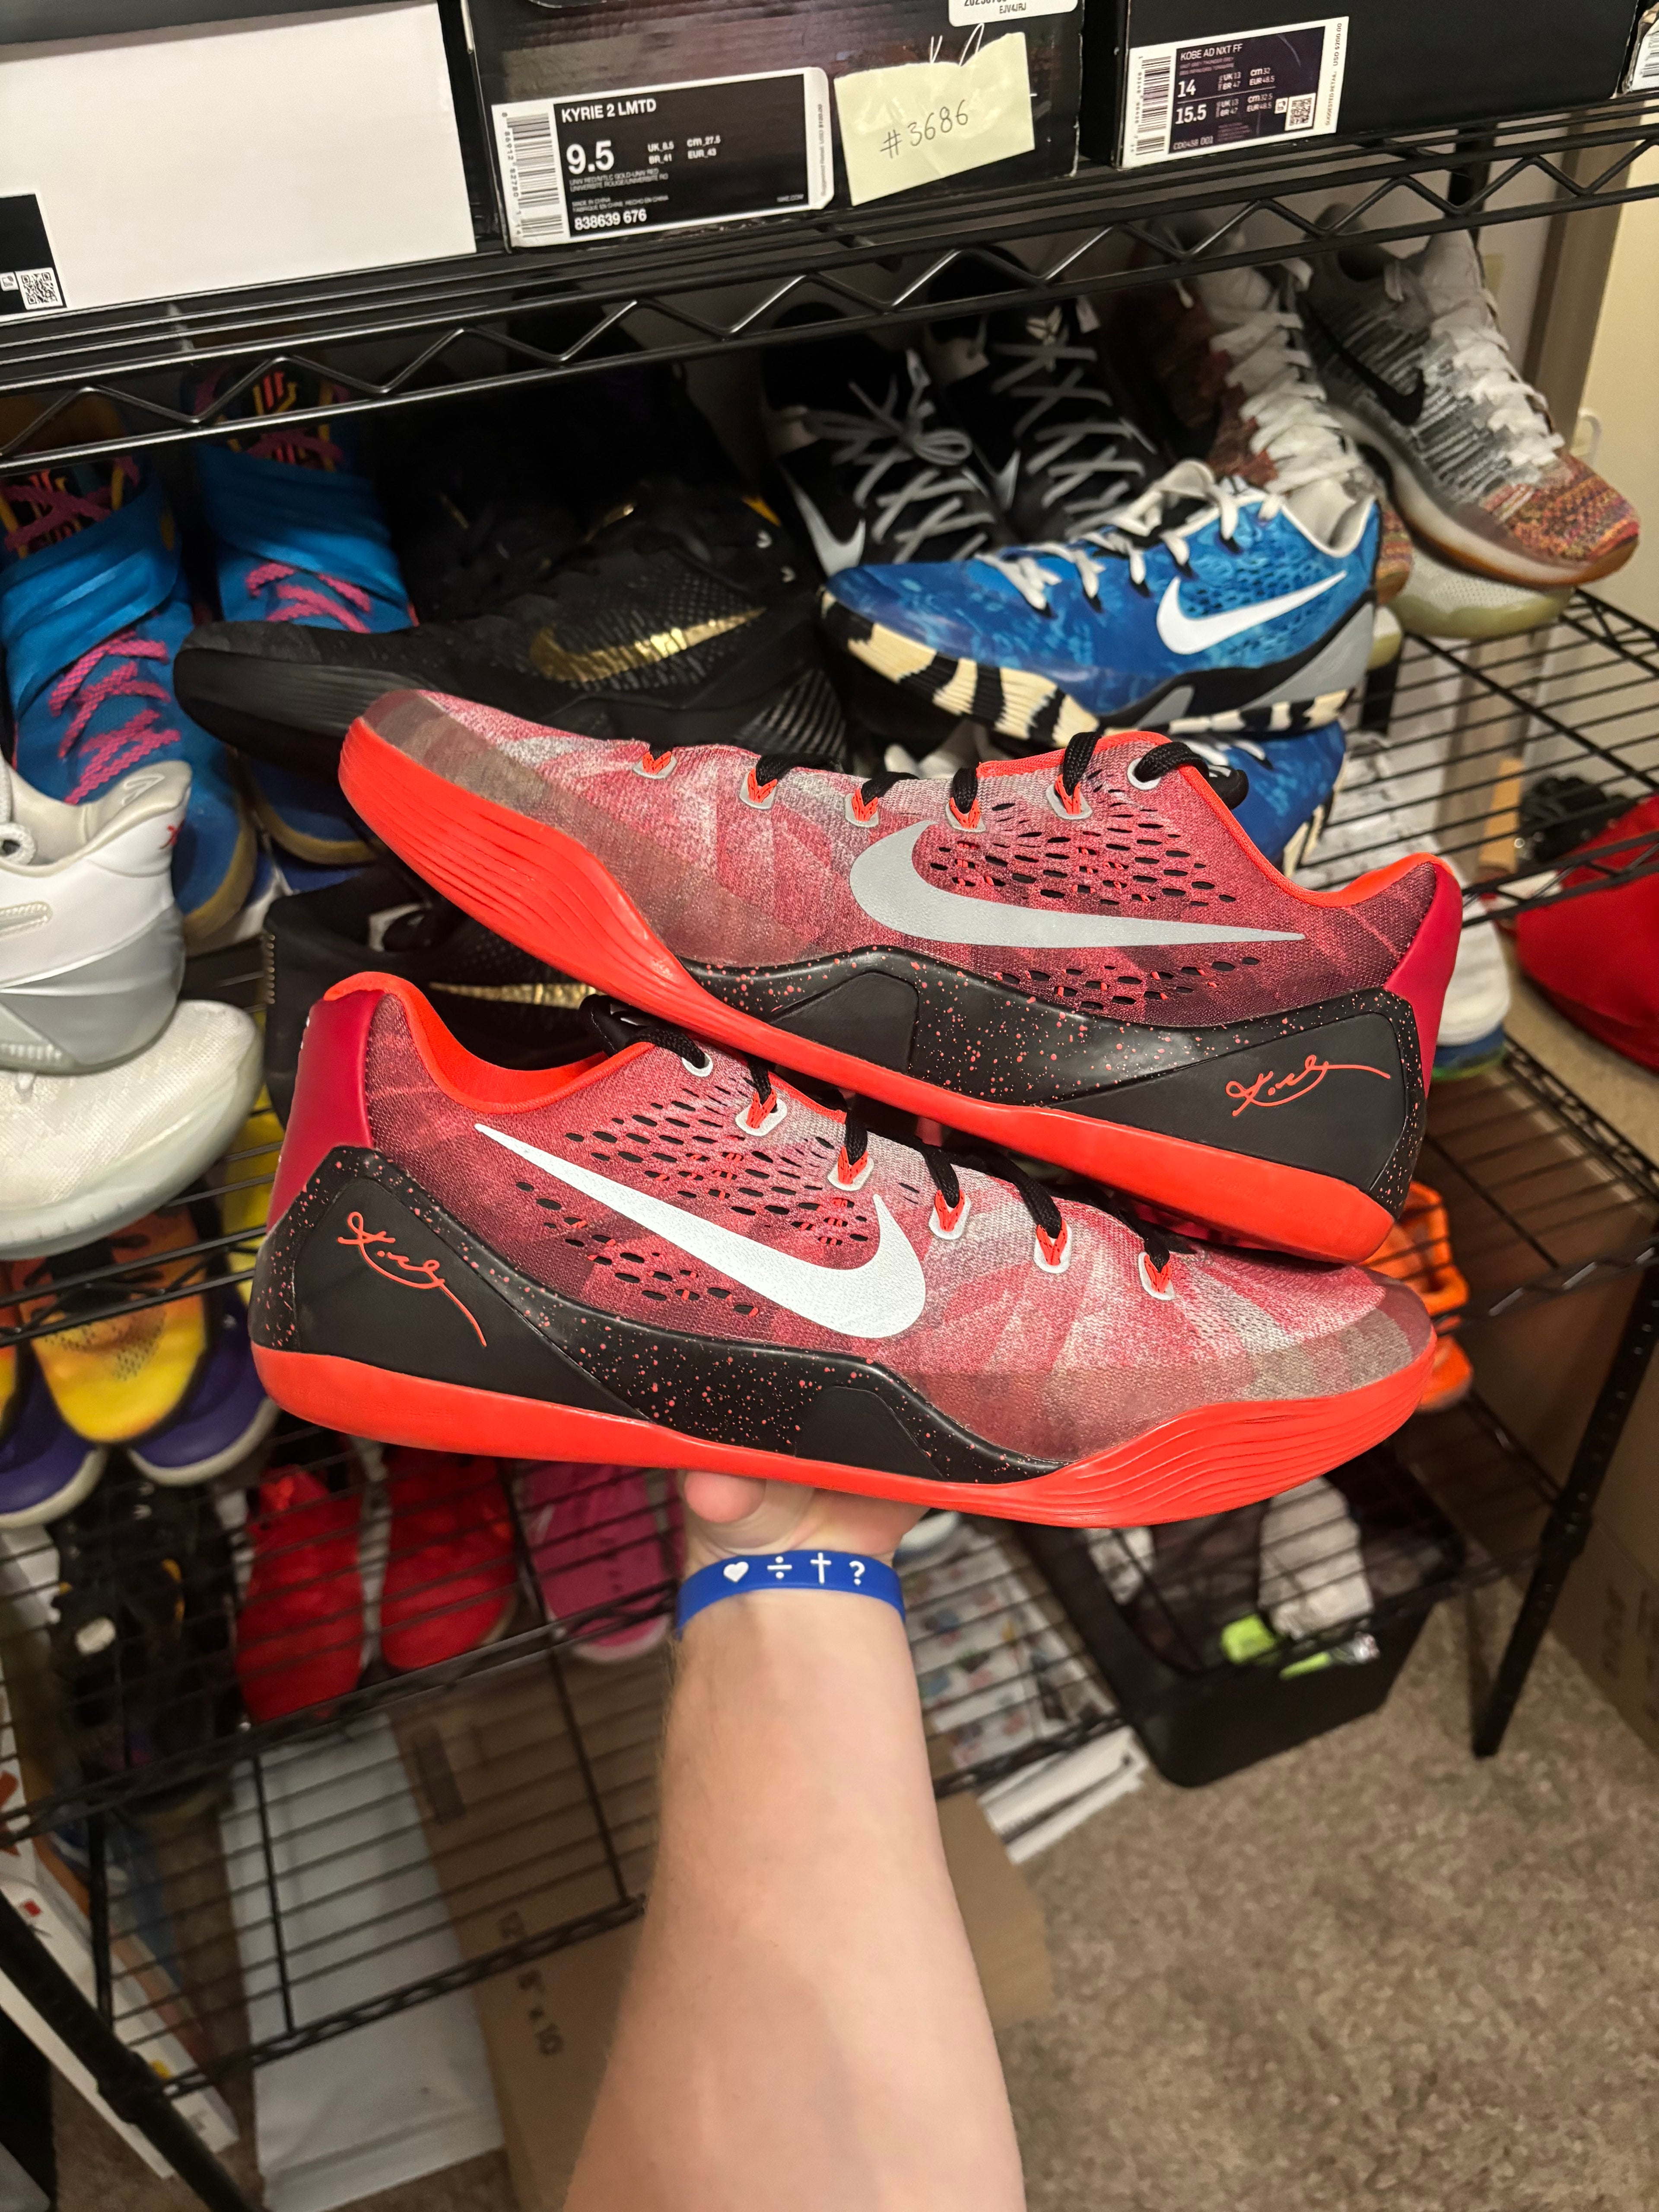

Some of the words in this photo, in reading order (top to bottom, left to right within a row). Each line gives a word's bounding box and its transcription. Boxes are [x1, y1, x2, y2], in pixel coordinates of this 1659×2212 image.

[1180, 50, 1202, 61] KOBE
[1203, 48, 1214, 57] AD
[1216, 45, 1232, 55] NXT
[1233, 43, 1243, 53] FF
[1177, 79, 1196, 98] 14
[562, 105, 604, 123] KYRIE
[607, 103, 616, 117] 2
[618, 98, 656, 116] LMTD
[1175, 104, 1207, 124] 15.5
[880, 99, 969, 158] #3686
[566, 140, 614, 175] 9.5
[574, 212, 620, 230] 838639
[623, 208, 647, 224] 676
